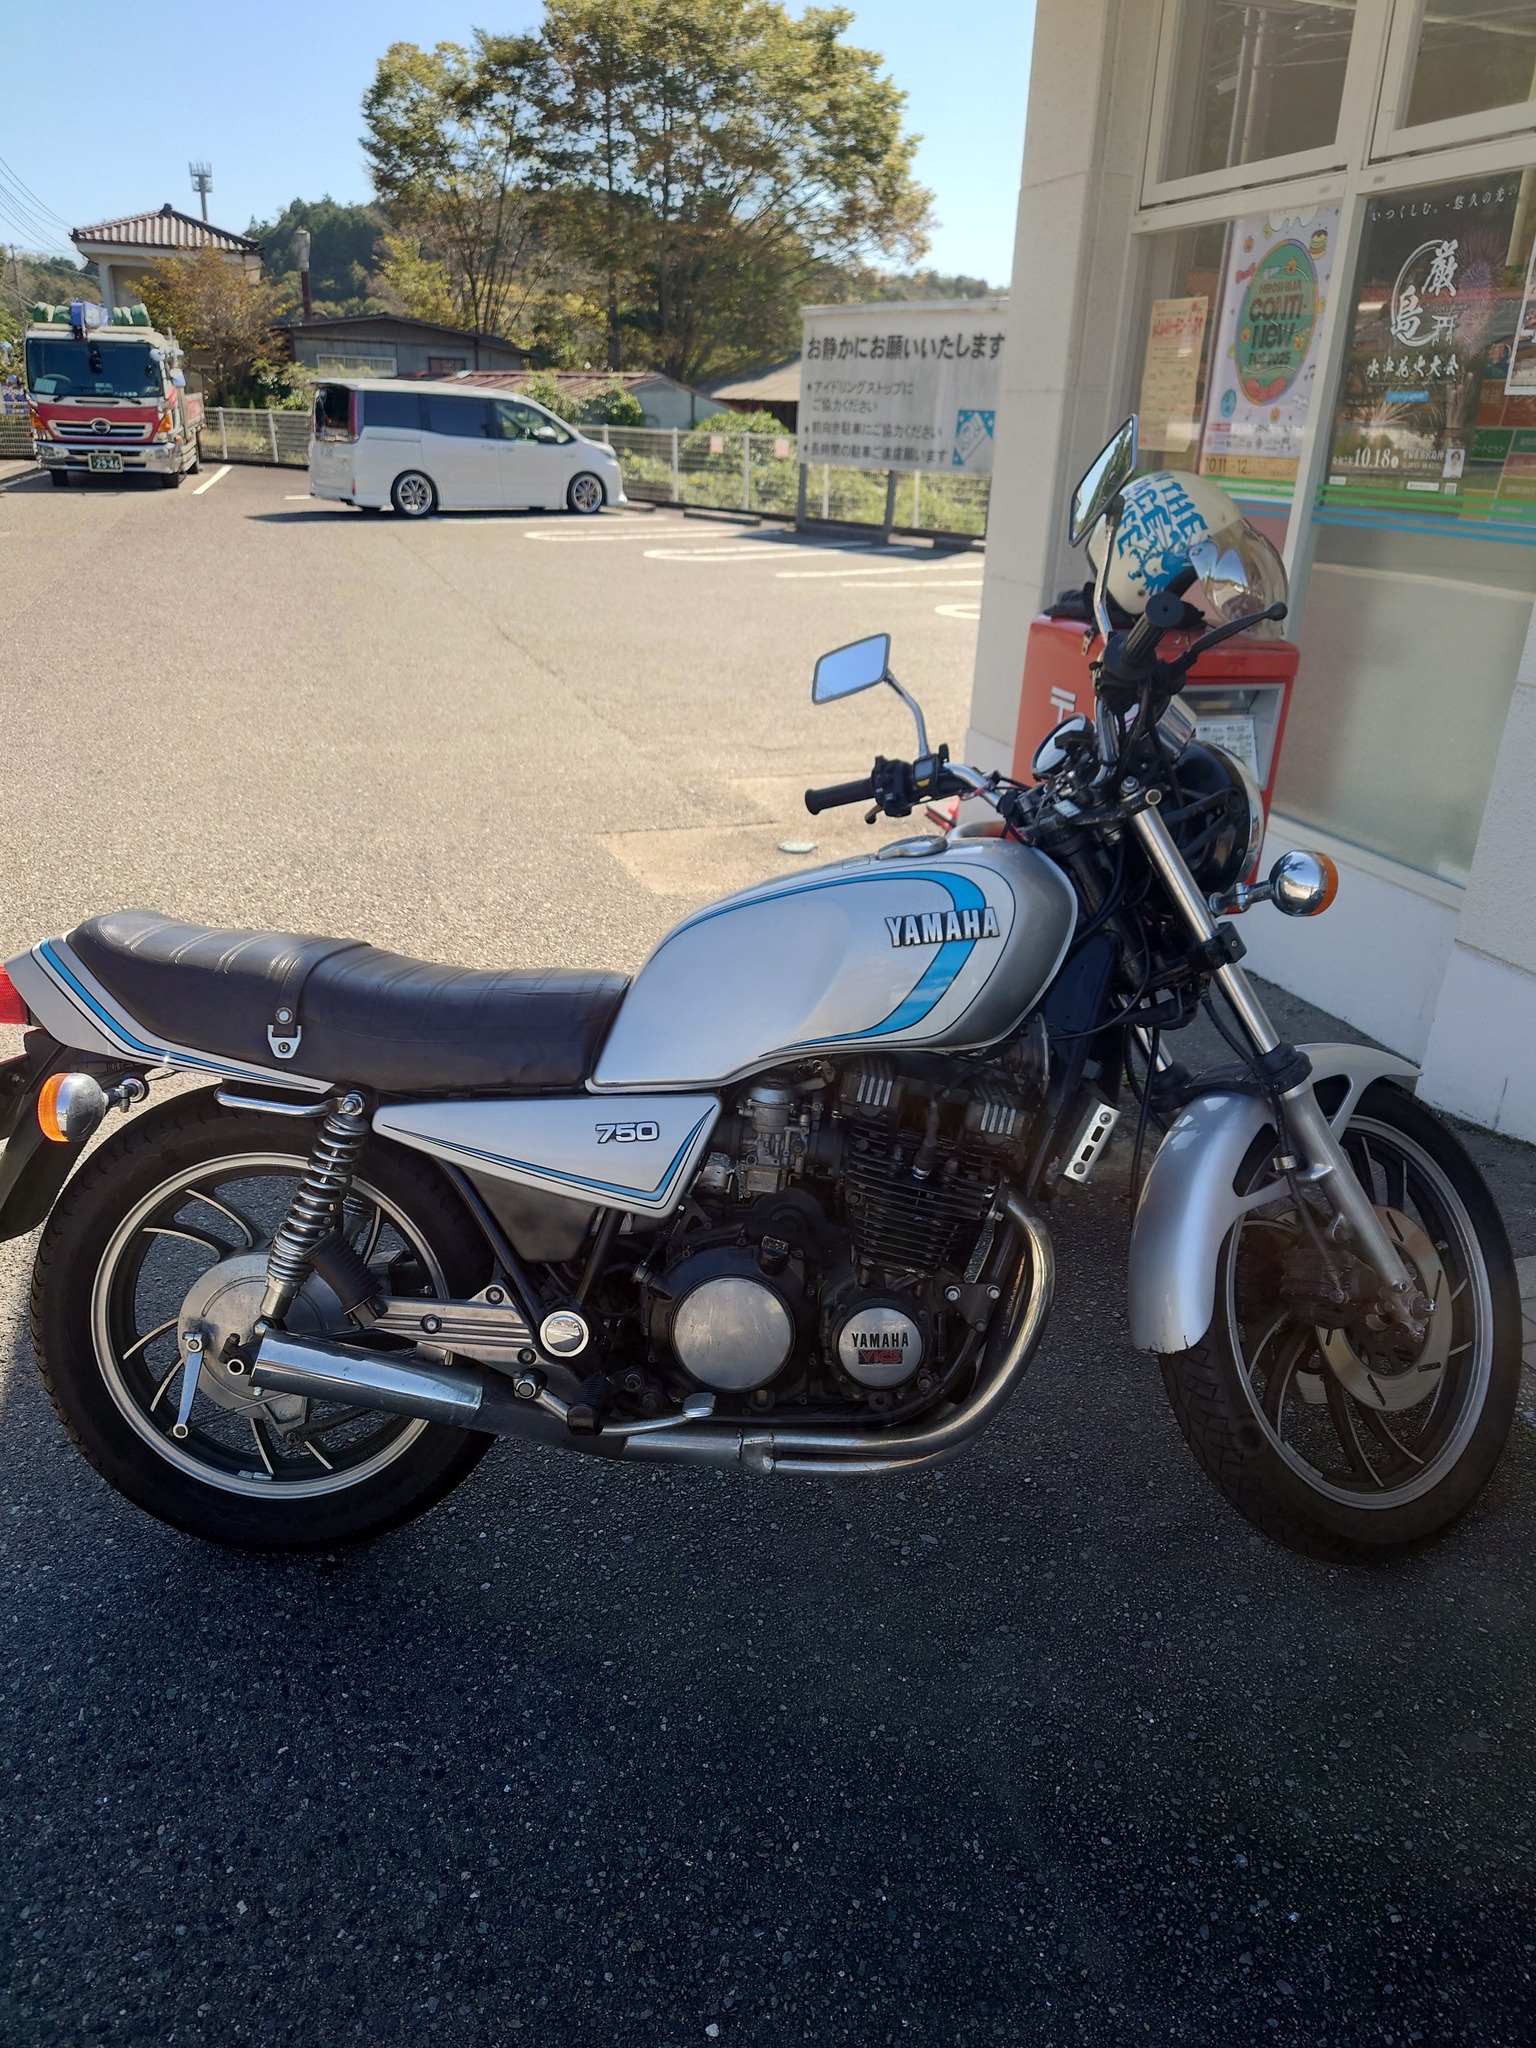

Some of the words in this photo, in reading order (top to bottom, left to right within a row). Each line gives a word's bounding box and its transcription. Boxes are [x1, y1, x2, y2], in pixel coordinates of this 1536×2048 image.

[807, 333, 1005, 361] お静かにお願いいたします
[814, 380, 914, 397] アイドリングストップに
[812, 399, 878, 414] ご協力ください
[1354, 447, 1392, 469] 10.18
[1160, 481, 1208, 540] THE
[884, 906, 1000, 948] YAMAHA
[595, 1120, 660, 1144] 750
[851, 1332, 909, 1348] YAMAHA
[860, 1350, 903, 1364] YICS
